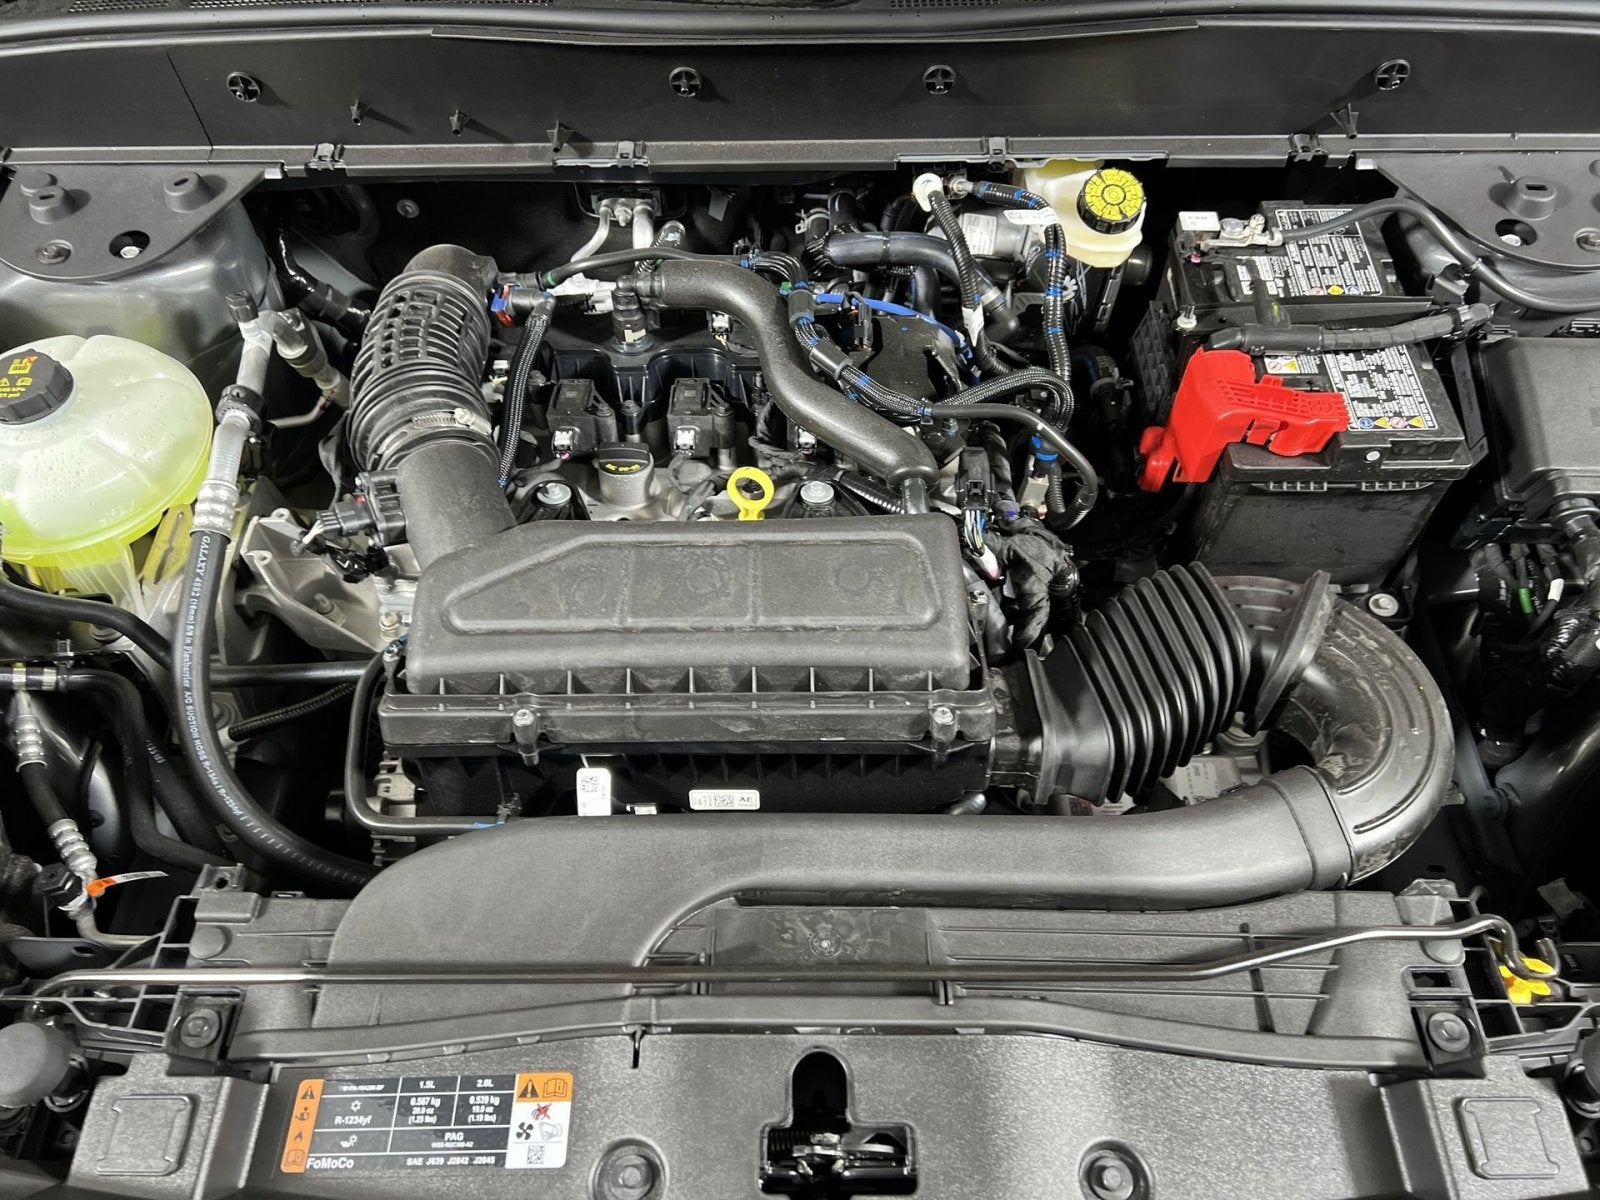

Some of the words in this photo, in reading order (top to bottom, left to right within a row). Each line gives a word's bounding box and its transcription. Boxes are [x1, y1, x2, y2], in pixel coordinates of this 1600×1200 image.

[196, 535, 211, 576] GALAXY
[191, 576, 204, 597] 4882
[182, 646, 193, 687] Flexbarrier
[185, 705, 200, 739] SUCTION
[194, 739, 208, 761] HOSE
[419, 1080, 436, 1089] 1.5L
[476, 1078, 494, 1088] 2.0L
[430, 1096, 441, 1107] kg
[489, 1095, 500, 1106] kg
[334, 1115, 373, 1126] R-1234yf
[444, 1132, 464, 1141] PAG
[306, 1157, 354, 1169] FoMoCo
[406, 1157, 424, 1166] SAE
